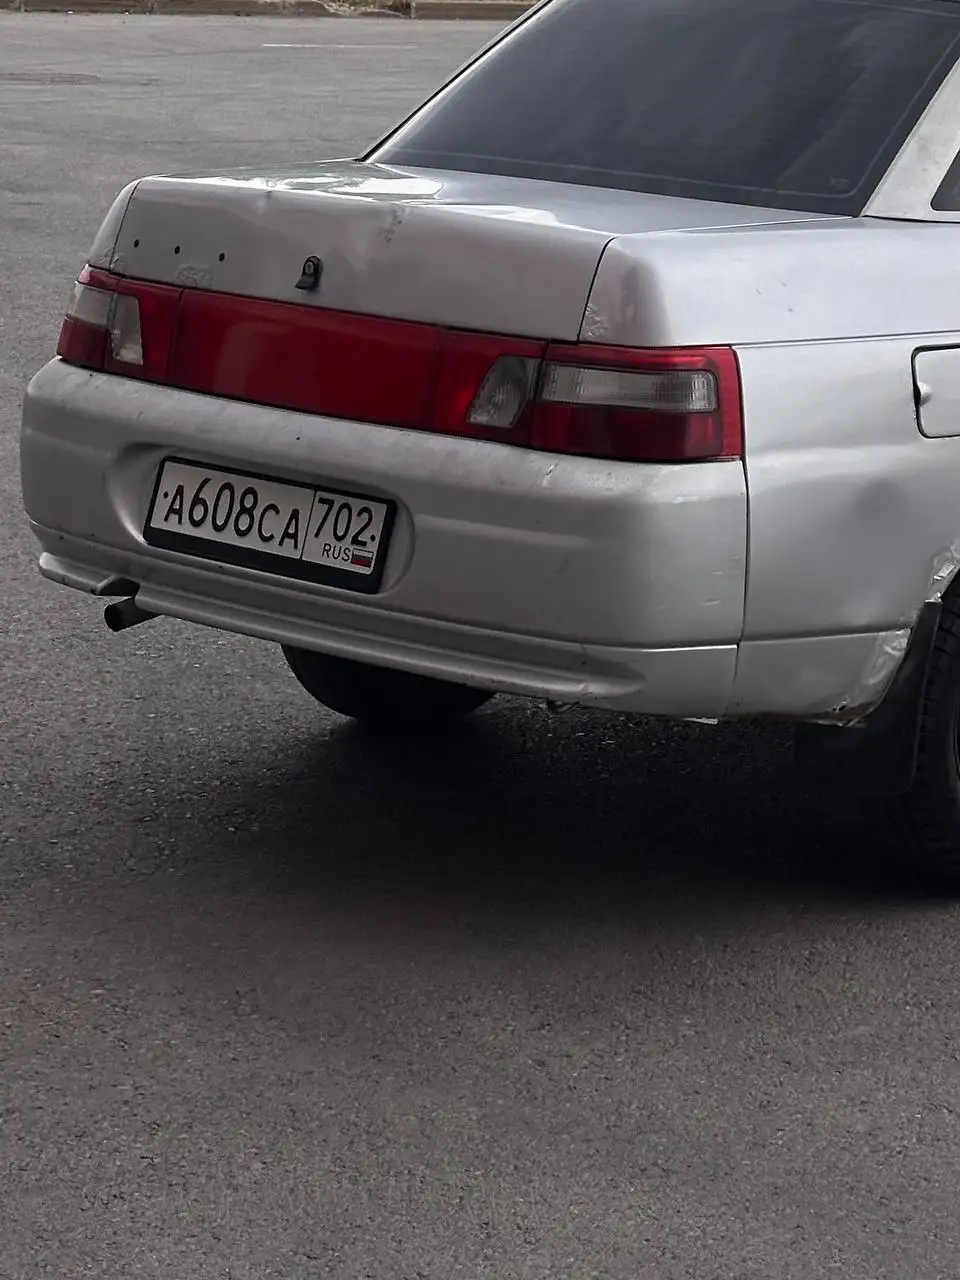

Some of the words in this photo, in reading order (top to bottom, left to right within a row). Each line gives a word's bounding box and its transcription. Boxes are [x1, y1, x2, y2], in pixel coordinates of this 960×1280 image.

[163, 477, 300, 550] А608СА
[314, 497, 374, 547] 702
[321, 542, 351, 562] RUS
